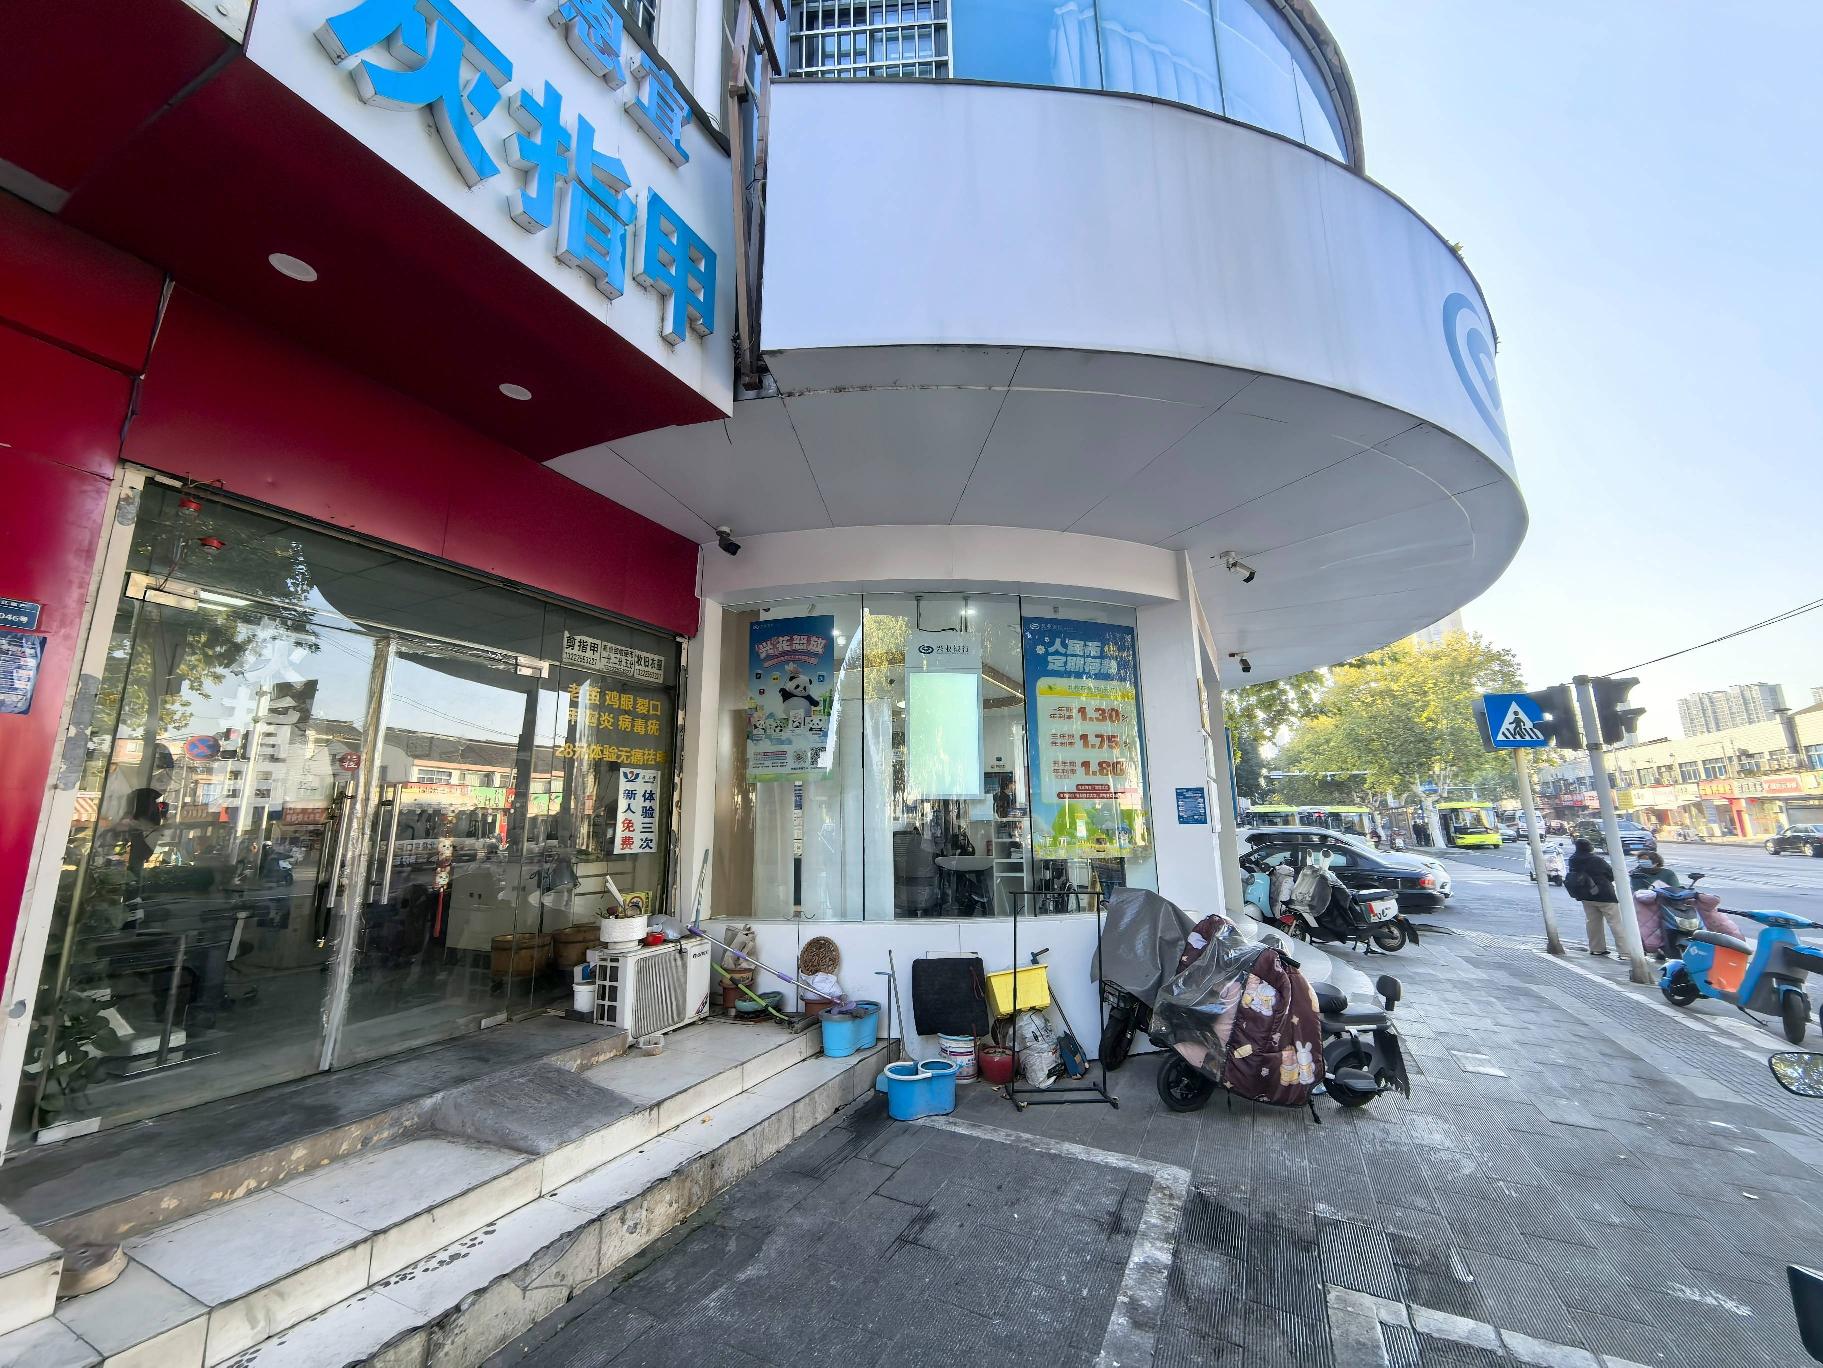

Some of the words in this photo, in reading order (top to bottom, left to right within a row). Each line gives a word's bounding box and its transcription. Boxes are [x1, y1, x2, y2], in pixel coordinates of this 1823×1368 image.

[565, 636, 599, 655] 剪指甲
[1047, 638, 1102, 656] 人民币
[605, 690, 633, 711] 鸡眼
[636, 697, 661, 716] 裂口
[620, 788, 637, 850] 新人免费
[638, 789, 655, 850] 体验三次
